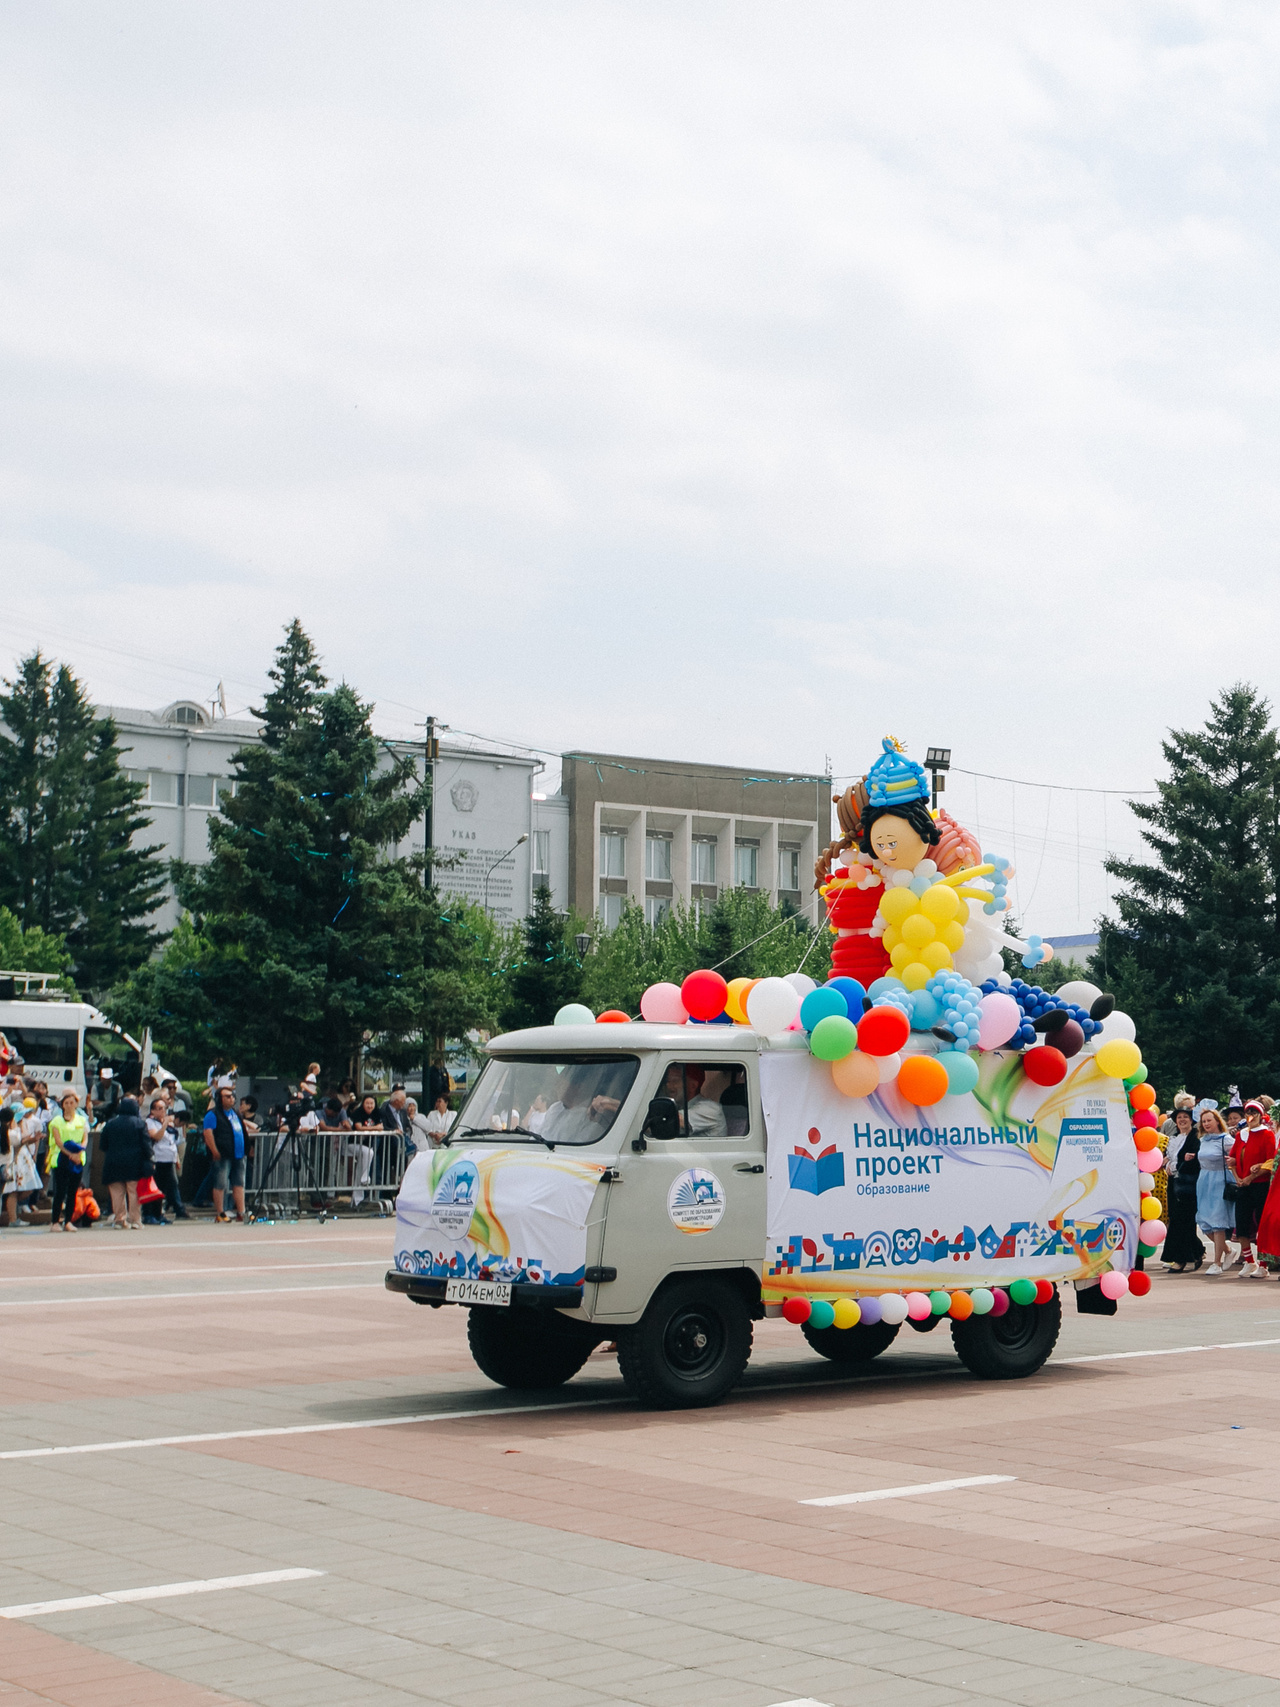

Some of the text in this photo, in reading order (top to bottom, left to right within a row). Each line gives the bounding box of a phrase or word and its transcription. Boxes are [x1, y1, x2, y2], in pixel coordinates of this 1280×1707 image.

[452, 829, 476, 840] УКАЗ
[853, 1118, 1039, 1152] Национальный
[855, 1154, 944, 1183] проект
[856, 1183, 931, 1198] Образование
[451, 1282, 507, 1301] Т014ЕМ 03
